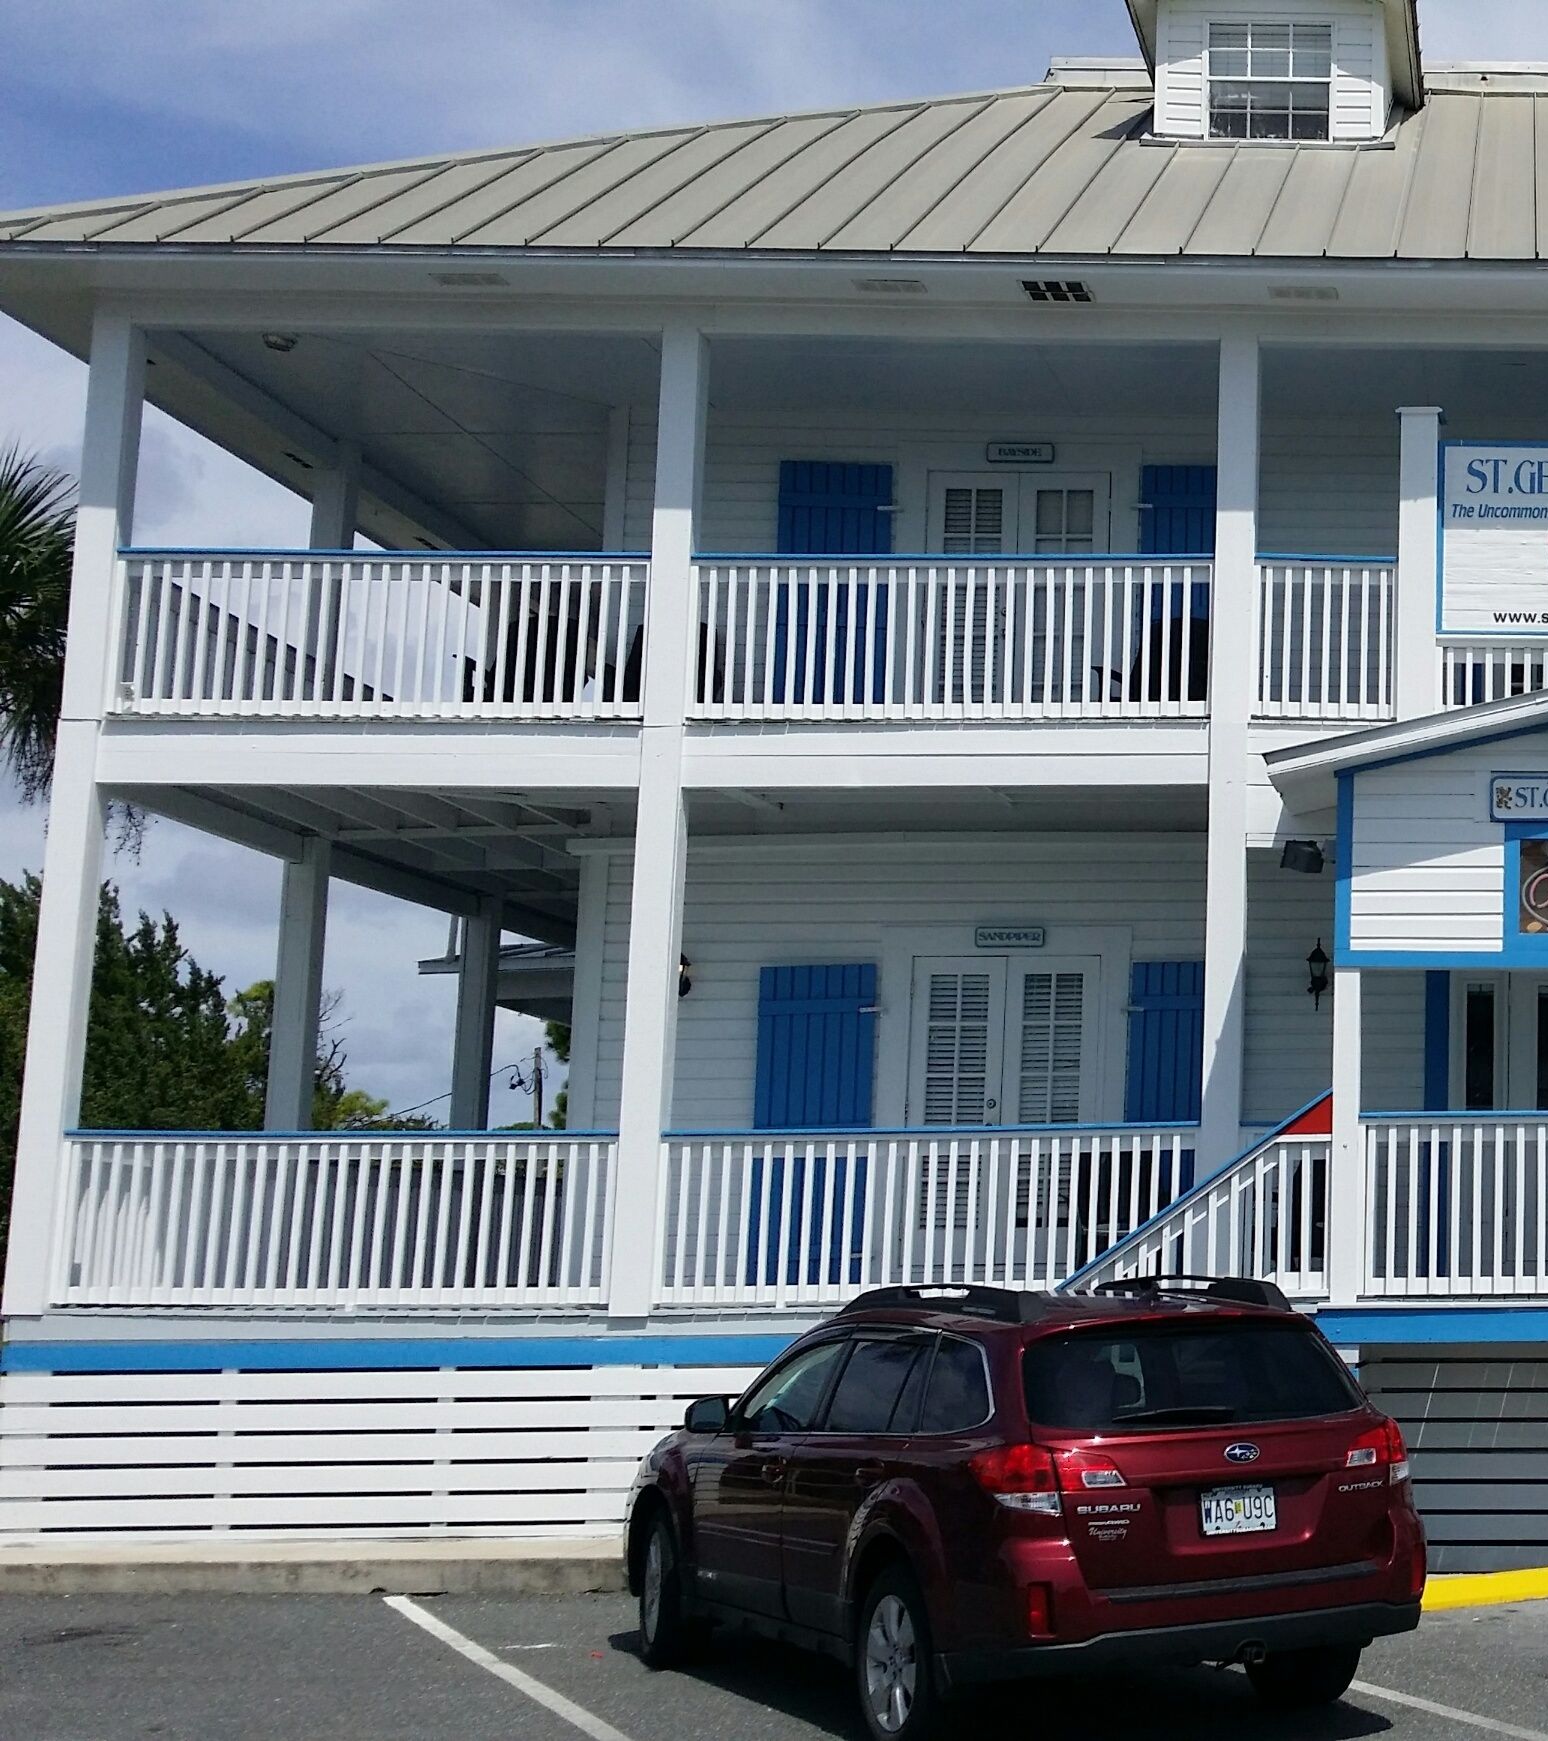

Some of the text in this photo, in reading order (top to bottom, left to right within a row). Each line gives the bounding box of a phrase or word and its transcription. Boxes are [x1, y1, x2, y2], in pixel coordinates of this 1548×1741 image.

[1452, 503, 1475, 518] The
[1478, 504, 1548, 519] Uncommon
[979, 932, 1041, 942] SANDPIPER
[1338, 1480, 1383, 1492] OUTBACK
[1077, 1503, 1141, 1514] SUBARU
